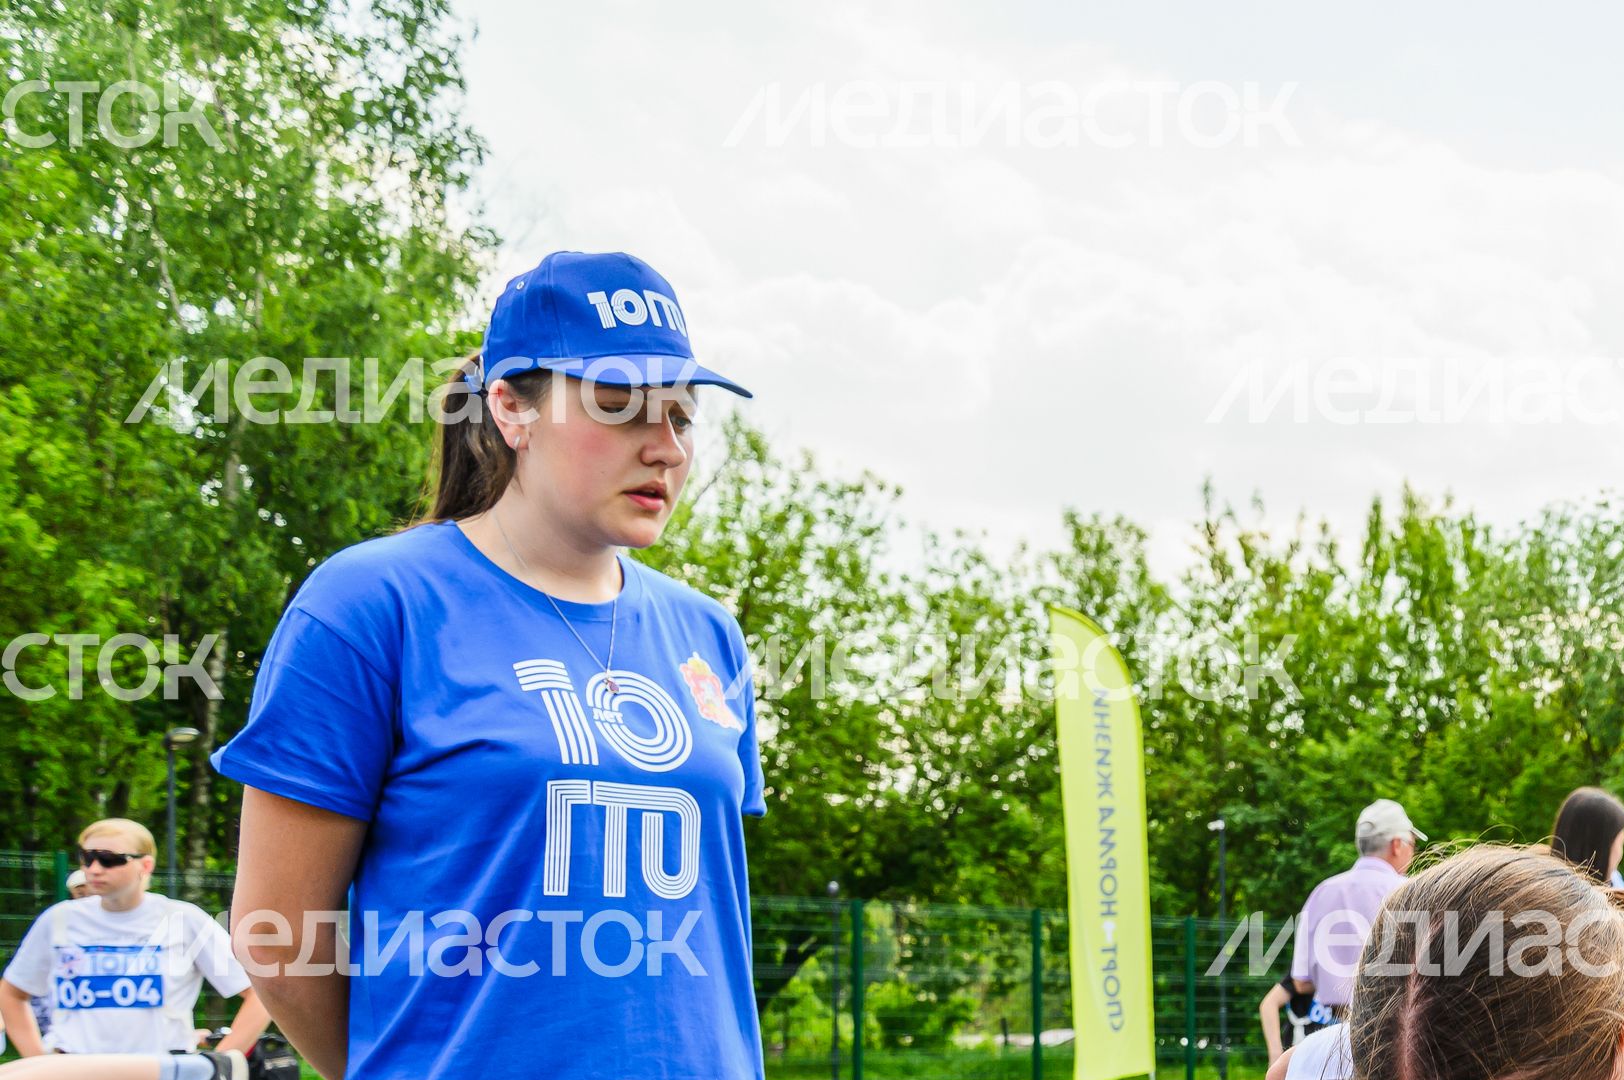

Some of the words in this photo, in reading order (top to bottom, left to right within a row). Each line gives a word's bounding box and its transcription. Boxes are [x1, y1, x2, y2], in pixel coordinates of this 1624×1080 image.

[512, 659, 693, 772] 10
[543, 779, 701, 899] ГТО
[59, 977, 161, 1008] 06-04
